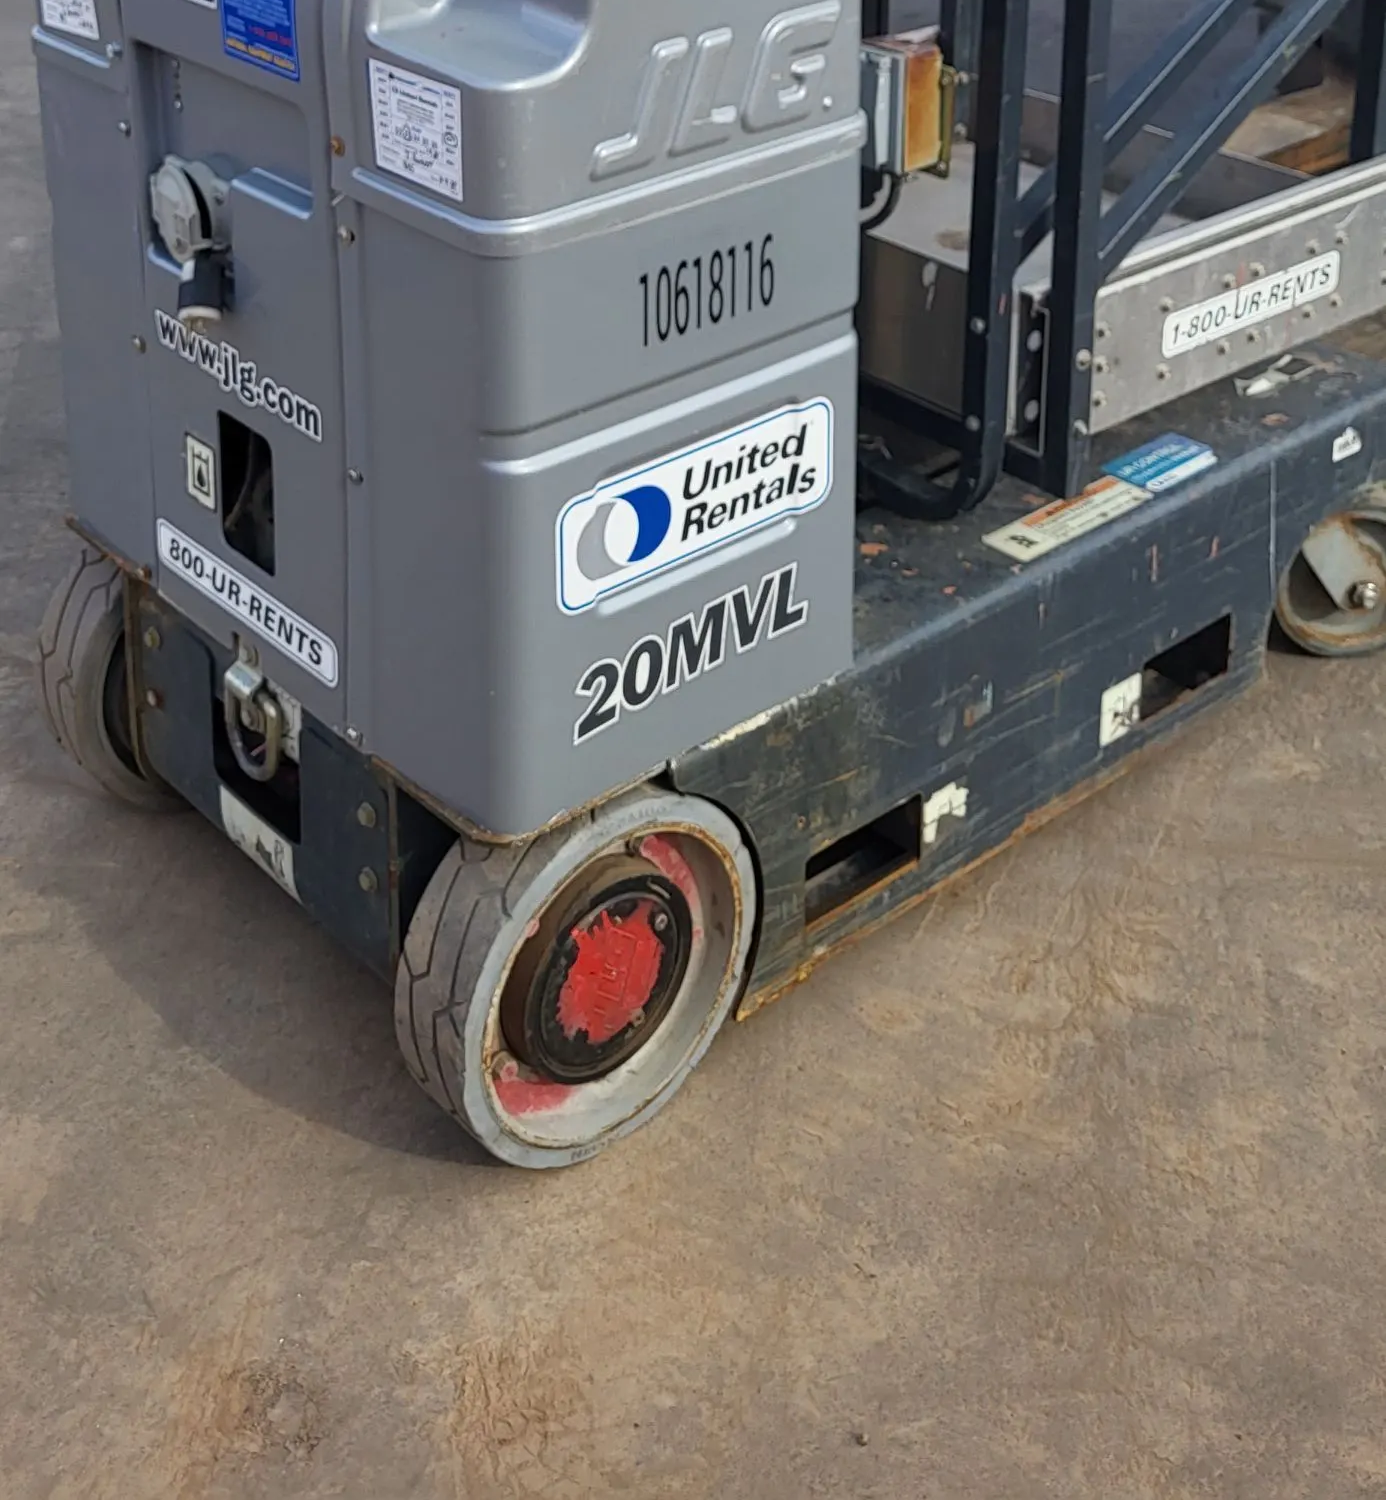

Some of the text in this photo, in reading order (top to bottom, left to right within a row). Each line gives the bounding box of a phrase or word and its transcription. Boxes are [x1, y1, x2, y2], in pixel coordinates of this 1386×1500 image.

[639, 233, 775, 347] 10618116
[1172, 263, 1332, 345] 1-800-UR-RENTS
[156, 310, 324, 442] www.jlg.com
[680, 463, 816, 542] Rentals
[682, 423, 808, 501] United
[168, 536, 323, 666] 800-UR-RENTS
[573, 561, 809, 745] 20MVL
